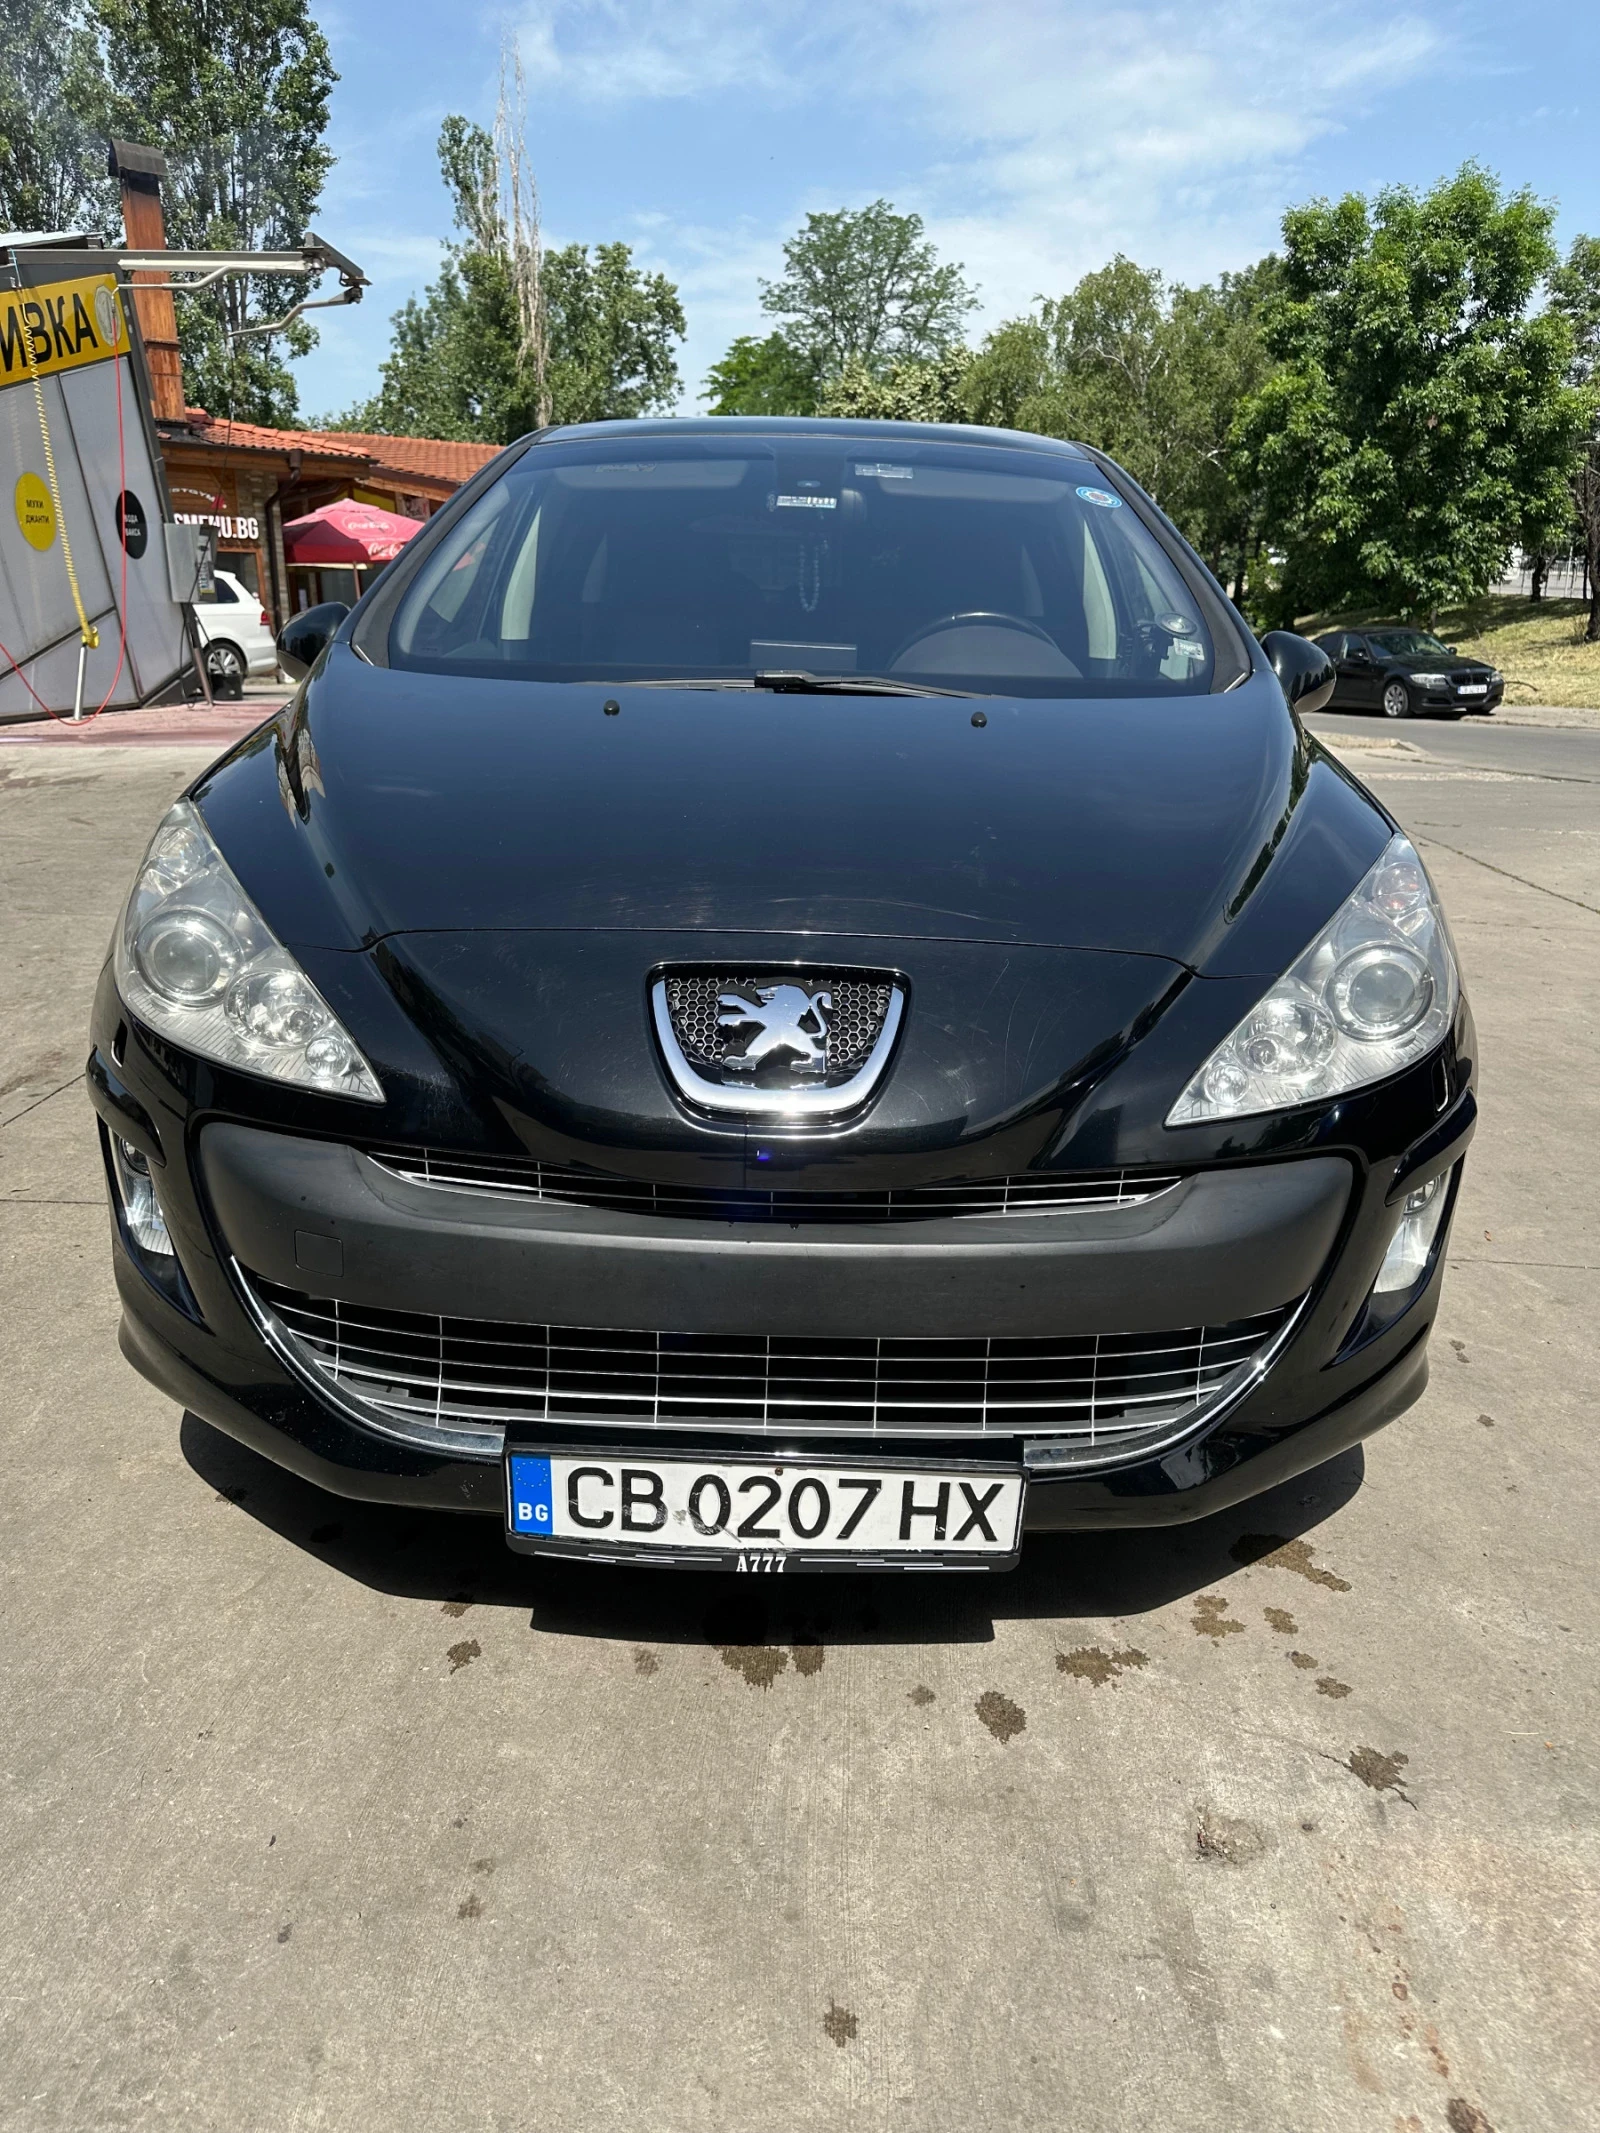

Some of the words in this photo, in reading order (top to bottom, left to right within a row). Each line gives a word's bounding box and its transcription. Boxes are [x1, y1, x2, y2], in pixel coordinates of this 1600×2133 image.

[518, 1502, 549, 1522] BG
[567, 1466, 668, 1532] CB
[688, 1474, 882, 1541] 0207
[898, 1481, 1004, 1542] HX
[736, 1554, 787, 1572] A777
